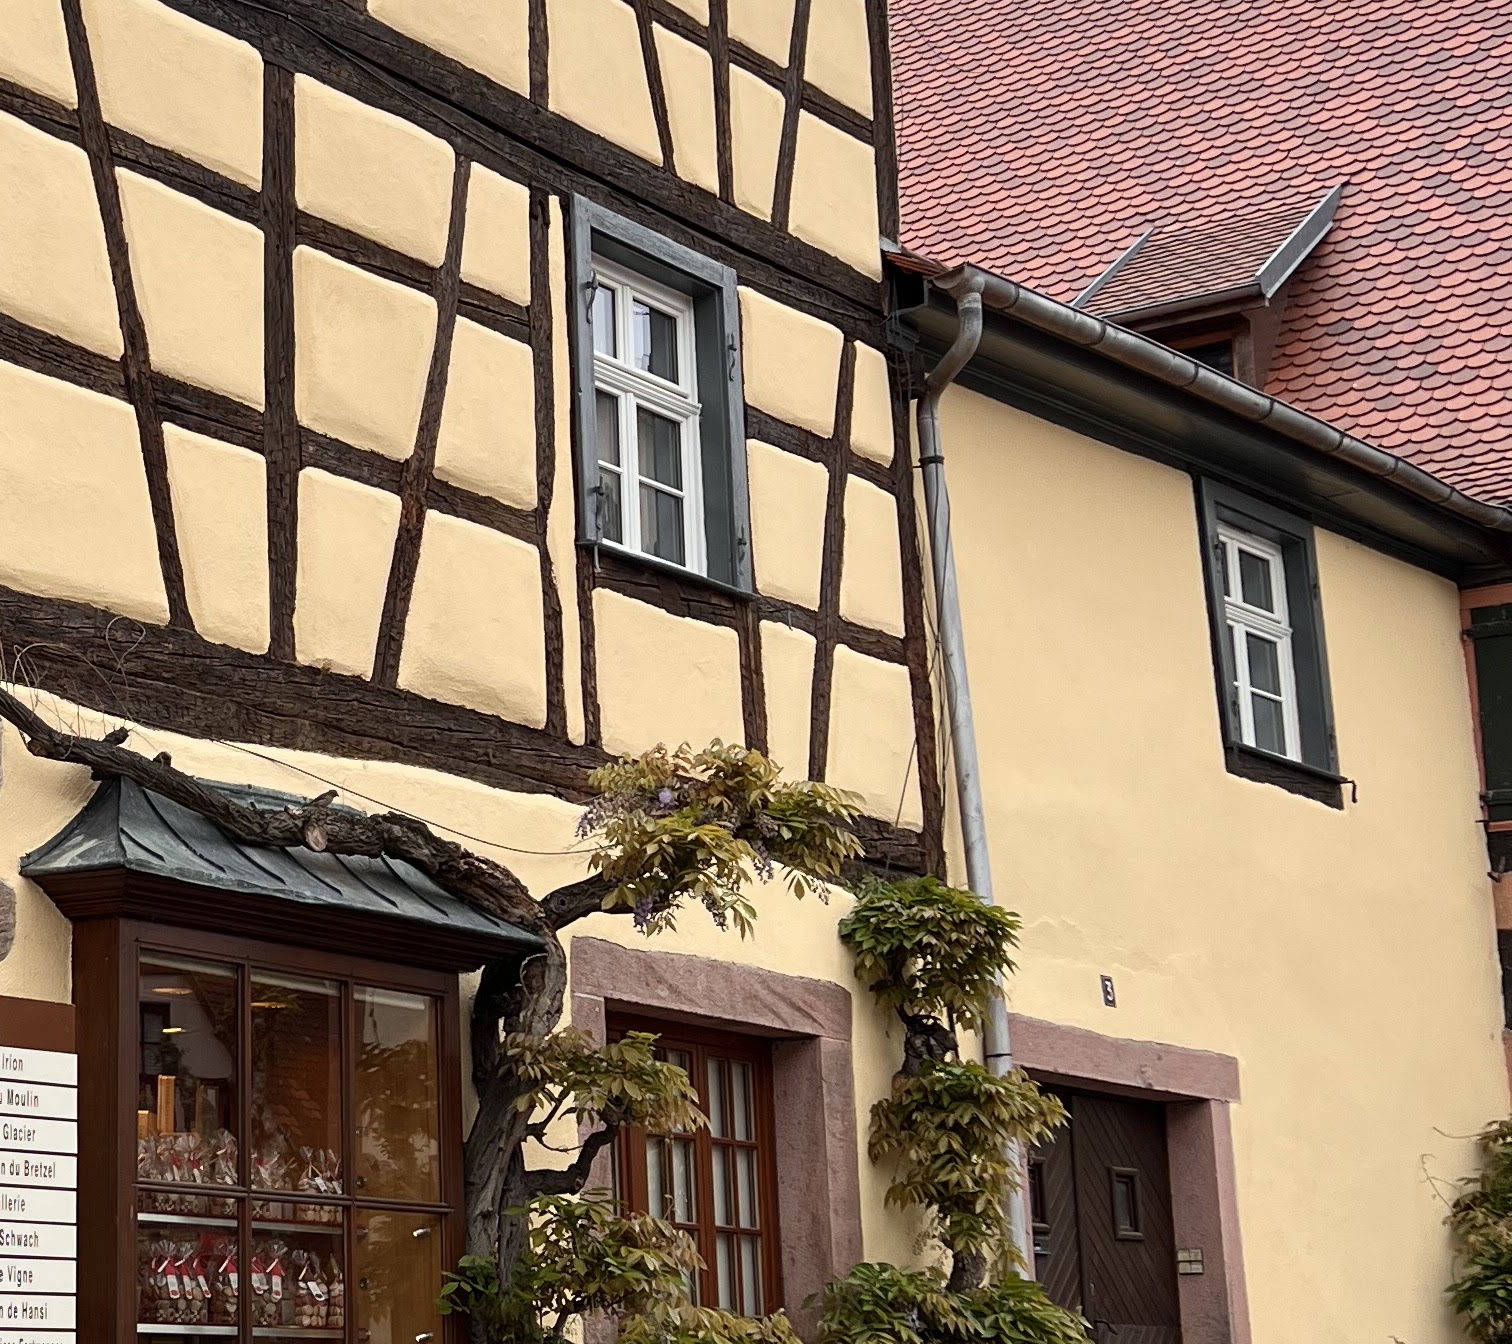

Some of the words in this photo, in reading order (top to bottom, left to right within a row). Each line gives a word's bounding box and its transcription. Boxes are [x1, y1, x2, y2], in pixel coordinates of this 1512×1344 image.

[1104, 980, 1114, 1001] 3
[2, 1053, 23, 1071] Irion
[7, 1089, 39, 1107] Moulin
[3, 1123, 35, 1142] Glacier
[10, 1159, 20, 1176] du
[24, 1160, 55, 1178] Bretzel
[0, 1229, 39, 1247] Schwach
[7, 1265, 33, 1287] Vigne
[8, 1302, 18, 1319] de
[22, 1302, 47, 1319] Hansi
